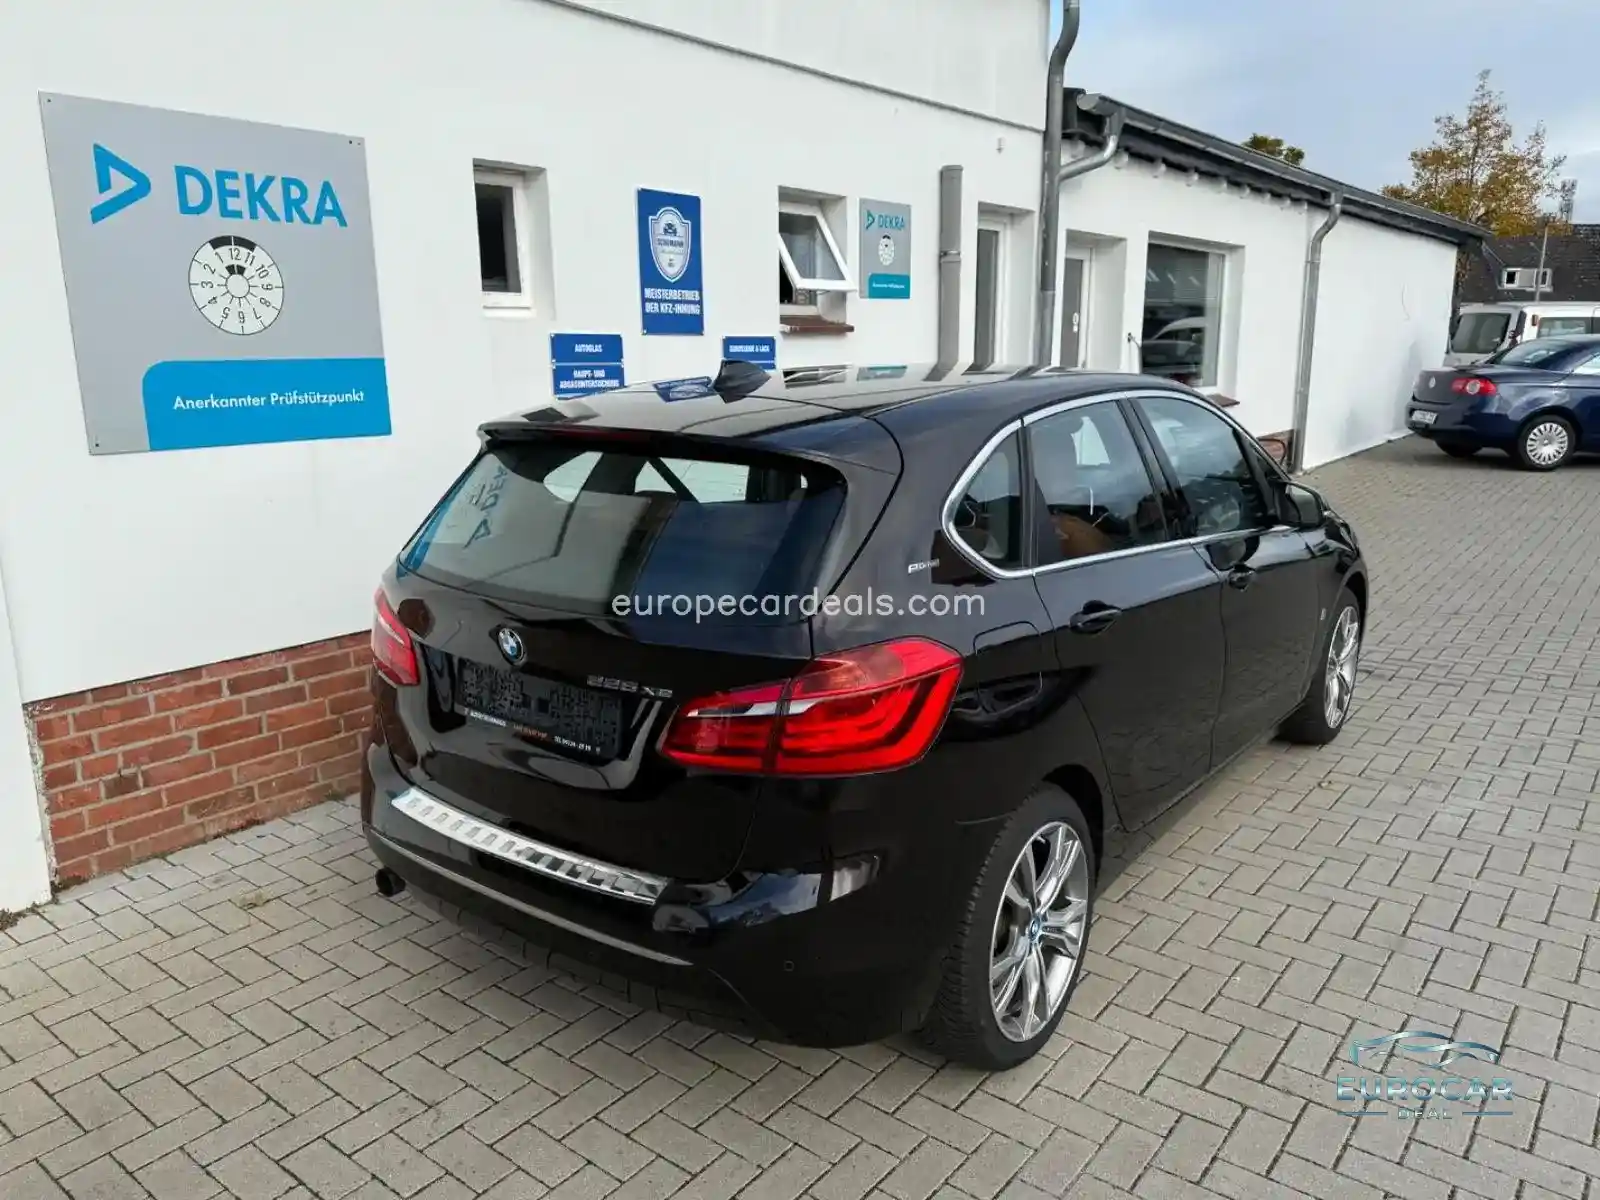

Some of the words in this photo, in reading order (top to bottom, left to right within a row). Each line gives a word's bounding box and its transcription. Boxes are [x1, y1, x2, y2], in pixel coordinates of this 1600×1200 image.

[174, 165, 348, 228] DEKRA
[878, 214, 905, 231] DEKRA
[215, 252, 223, 263] 1
[228, 247, 241, 260] 12
[244, 252, 255, 266] 11
[203, 263, 216, 274] 2
[256, 264, 269, 279] 10
[201, 281, 214, 289] 3
[644, 287, 700, 301] MEISTERBETRIEB
[259, 297, 271, 307] 8
[645, 301, 660, 313] DER
[222, 306, 230, 320] 5
[238, 311, 245, 324] 6
[252, 307, 262, 320] 7
[173, 393, 266, 411] Anerkannter
[270, 388, 365, 409] Prüfstützpunkt
